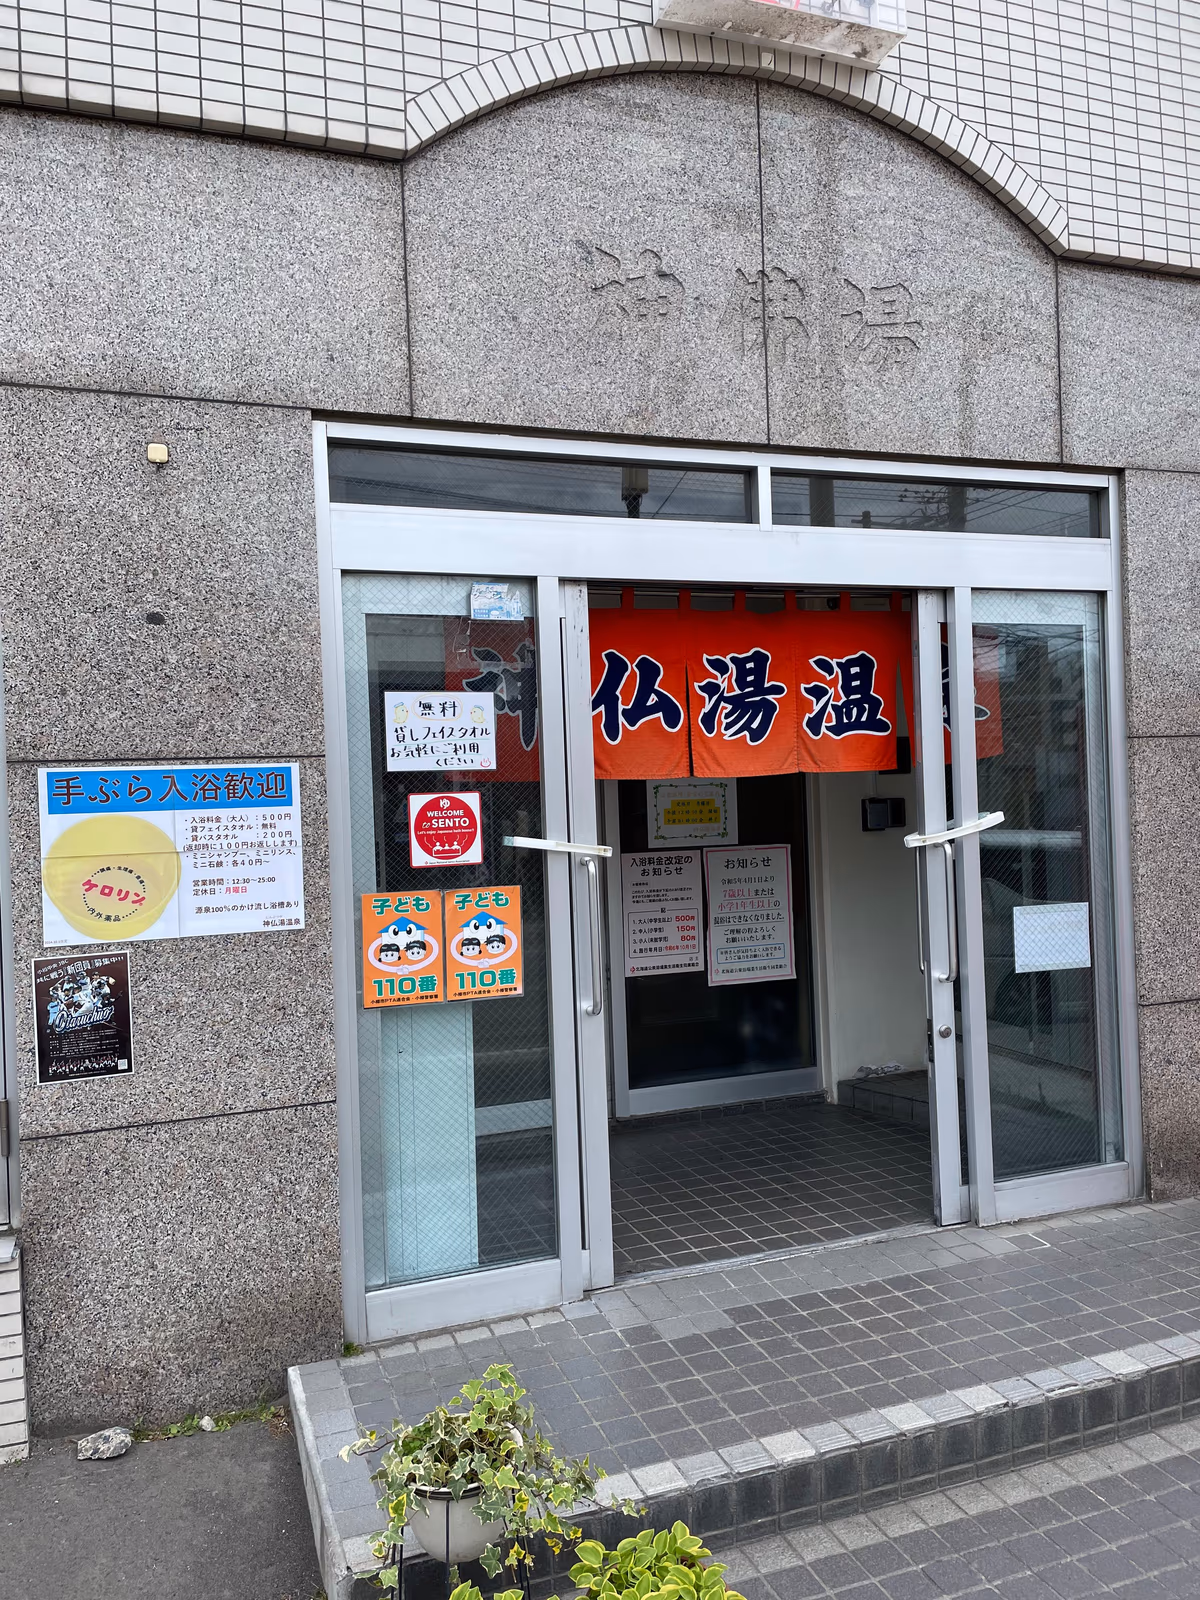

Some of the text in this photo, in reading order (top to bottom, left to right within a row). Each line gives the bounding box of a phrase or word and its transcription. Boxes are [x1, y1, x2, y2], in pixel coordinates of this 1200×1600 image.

[418, 700, 458, 717] 無料
[394, 725, 491, 744] 貸しフェイスタオル
[390, 742, 480, 758] お気軽にご利用
[435, 757, 475, 767] ください
[52, 771, 287, 806] 手ぶら入浴歓迎
[426, 810, 464, 818] WELCOME
[422, 818, 470, 829] to SENTO
[630, 855, 693, 868] 入浴料金改定の
[724, 856, 772, 869] お知らせ
[640, 866, 684, 877] お知らせ
[721, 875, 775, 886] 令和5年4月1日より
[82, 879, 146, 905] ケロリン
[722, 887, 775, 899] 7歳以上または
[372, 890, 510, 915] 子ども 子ども
[717, 899, 781, 912] 小学1年生以上の
[88, 907, 122, 922] 内外薬品
[675, 914, 696, 922] 500円
[262, 917, 302, 928] 神仏湯温泉
[676, 924, 696, 932] 150円
[680, 934, 697, 942] 80円
[372, 967, 517, 997] 110番 110番
